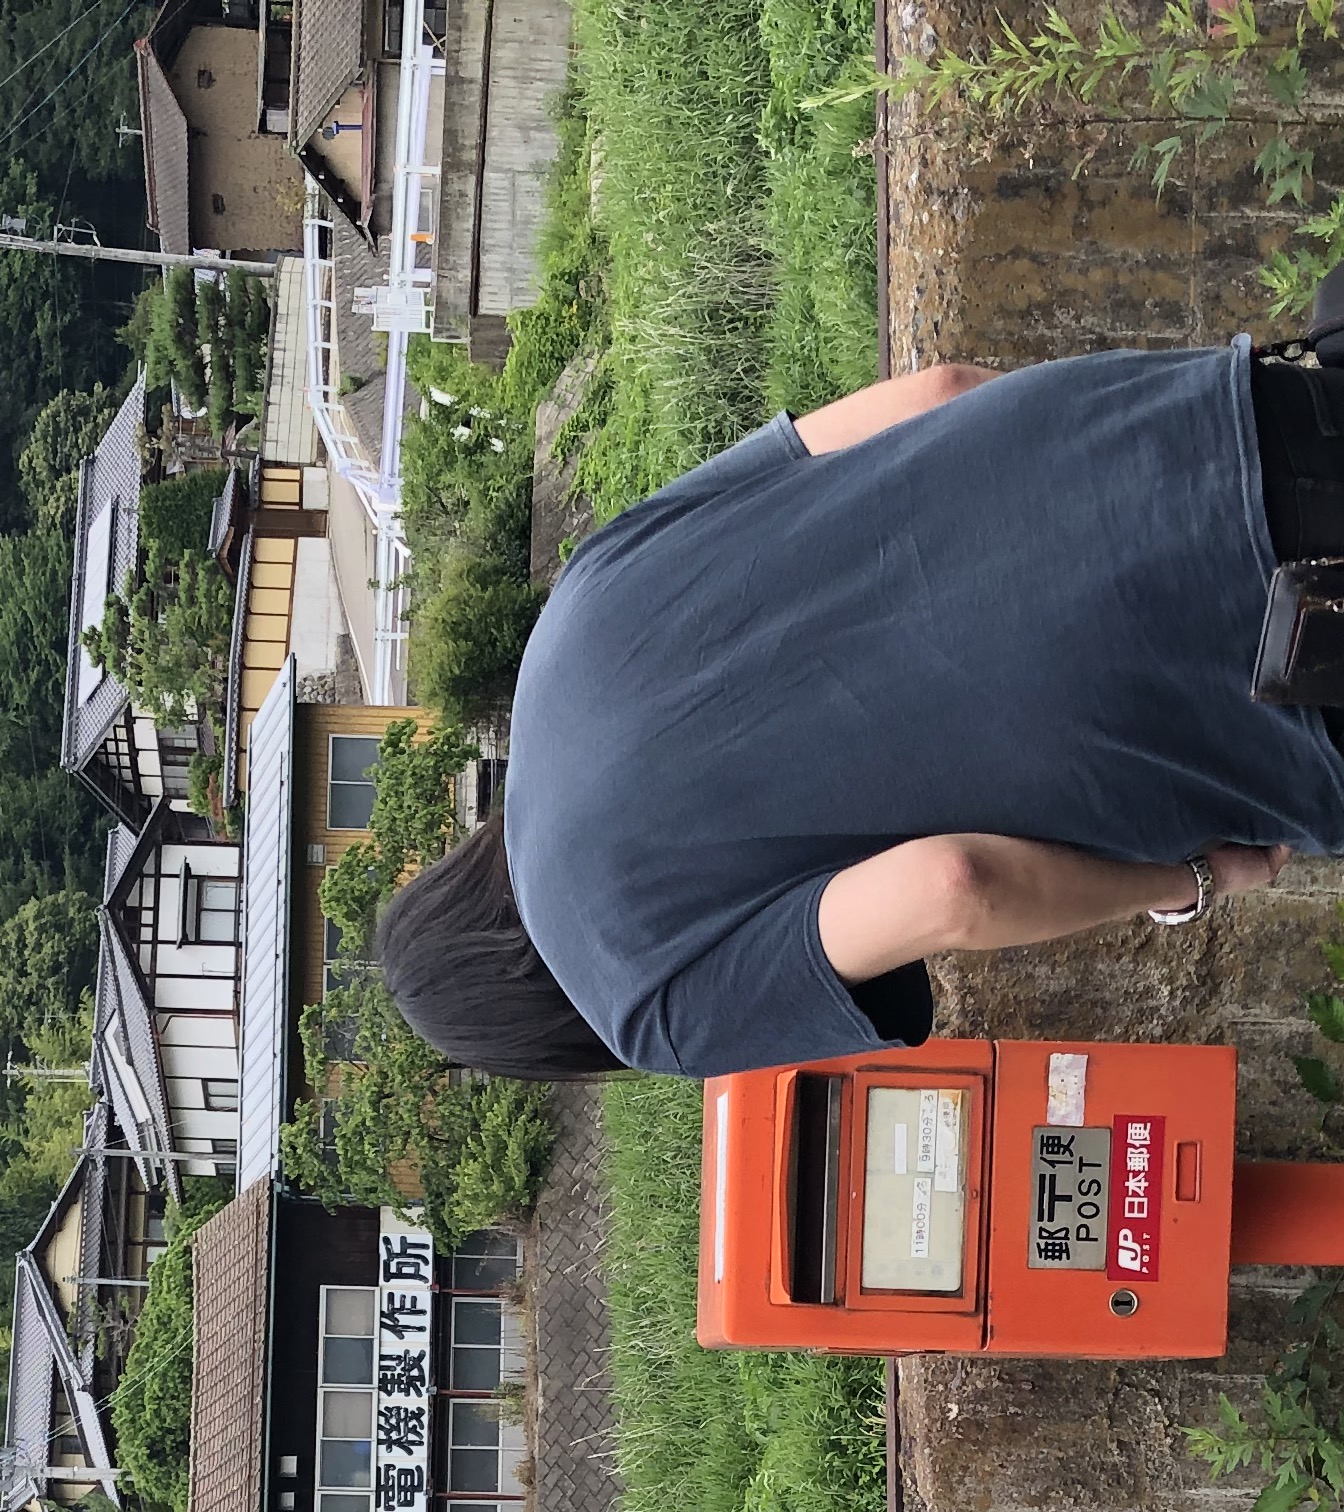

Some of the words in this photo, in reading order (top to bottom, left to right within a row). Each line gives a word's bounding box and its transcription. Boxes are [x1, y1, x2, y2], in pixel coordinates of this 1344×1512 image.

[1076, 1155, 1102, 1243] POST
[1124, 1122, 1151, 1218] 日本郵便
[1117, 1228, 1141, 1272] JP
[1141, 1232, 1151, 1274] POST
